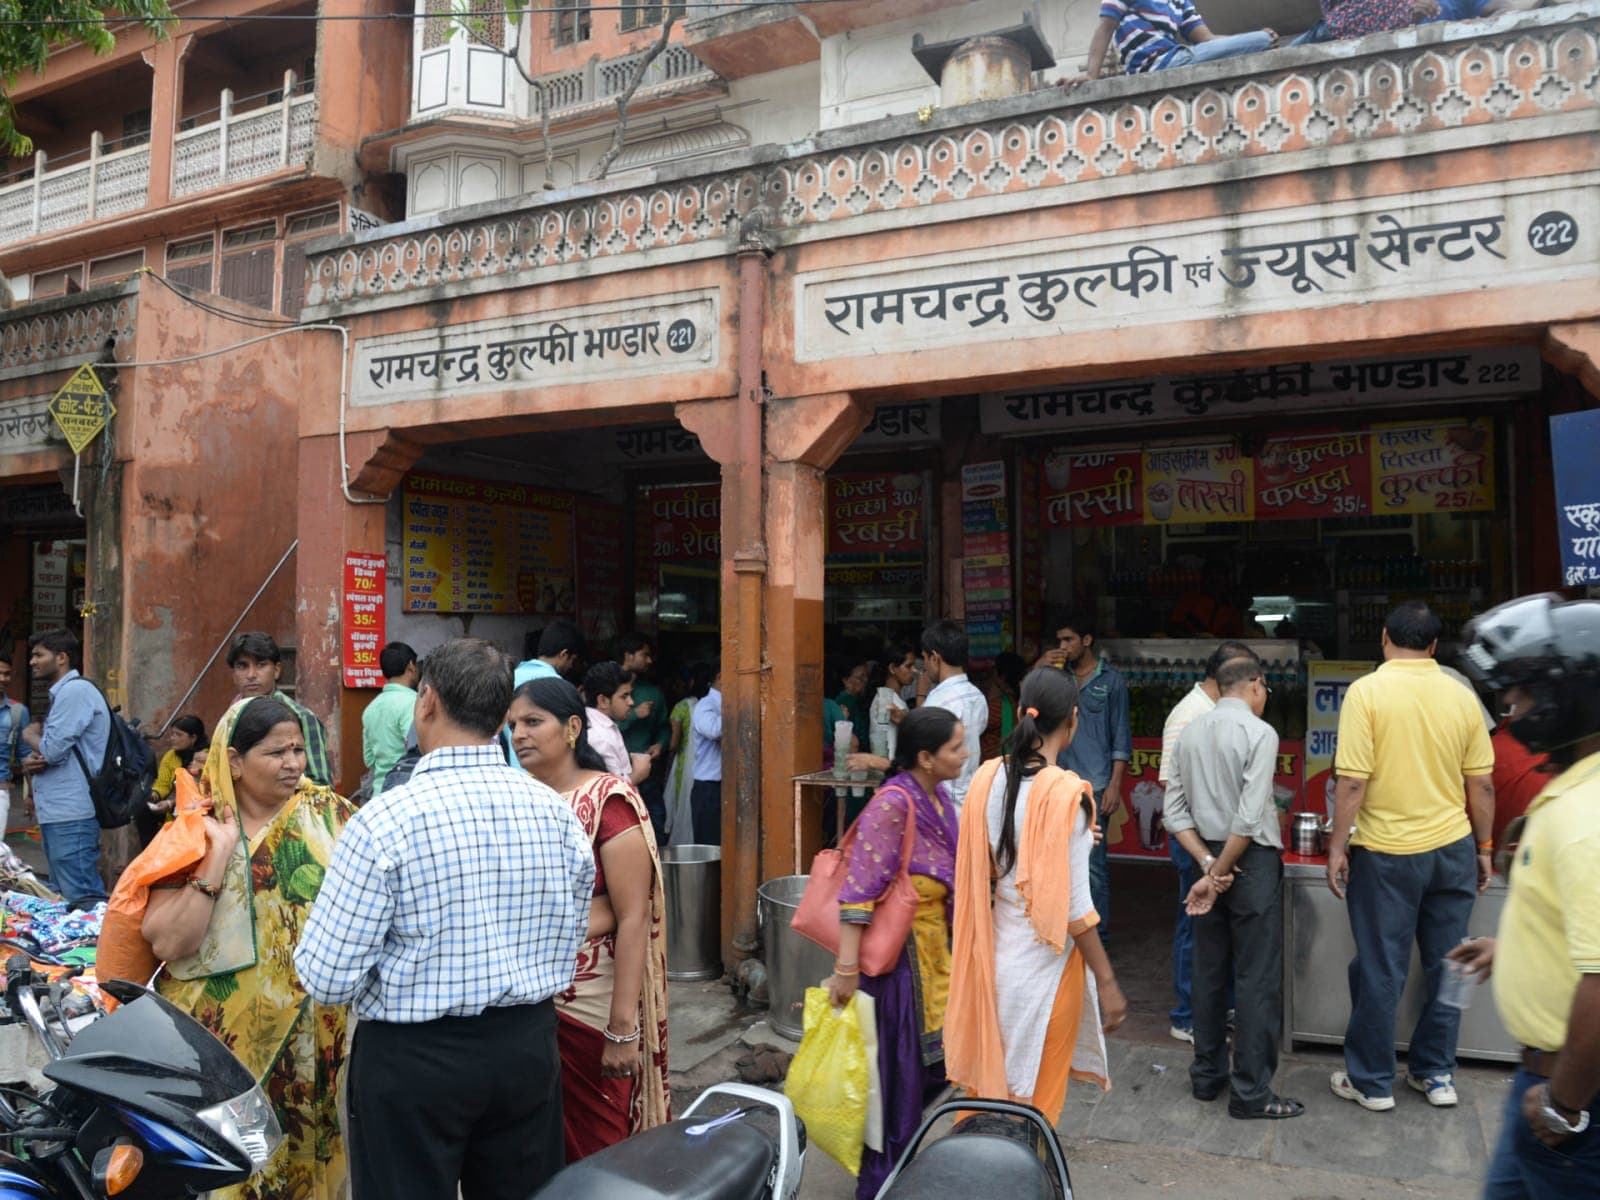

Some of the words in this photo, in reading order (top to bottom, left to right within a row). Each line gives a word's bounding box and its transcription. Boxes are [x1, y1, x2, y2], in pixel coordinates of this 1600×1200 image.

[824, 275, 1011, 336] रामचन्द्र
[1016, 244, 1179, 322] कुल्फी
[1183, 253, 1215, 288] एवं
[1216, 233, 1361, 294] ज्यूस
[1366, 214, 1507, 273] सेन्टर
[1530, 219, 1574, 249] 222
[368, 345, 482, 390] रामचन्द्र
[486, 322, 579, 382] कुल्फी
[584, 320, 661, 360] भण्डार
[669, 326, 692, 348] 221
[1003, 382, 1154, 421] रामचन्द्र
[1330, 355, 1472, 393] भण्डार
[1478, 362, 1521, 384] 222
[0, 407, 53, 440] सेलर
[1175, 469, 1248, 513] लस्सी
[1377, 450, 1488, 507] कुल्फी
[892, 488, 923, 507] 30/-
[1046, 465, 1136, 525] लस्सी
[1332, 495, 1368, 514] 35/-
[1434, 491, 1488, 508] 25/-
[835, 509, 921, 550] रबड़ी
[38, 592, 56, 601] DRY
[354, 578, 377, 589] 70/-
[32, 604, 64, 615] FRUITS
[353, 614, 377, 625] 35/-
[353, 652, 377, 663] 35/-
